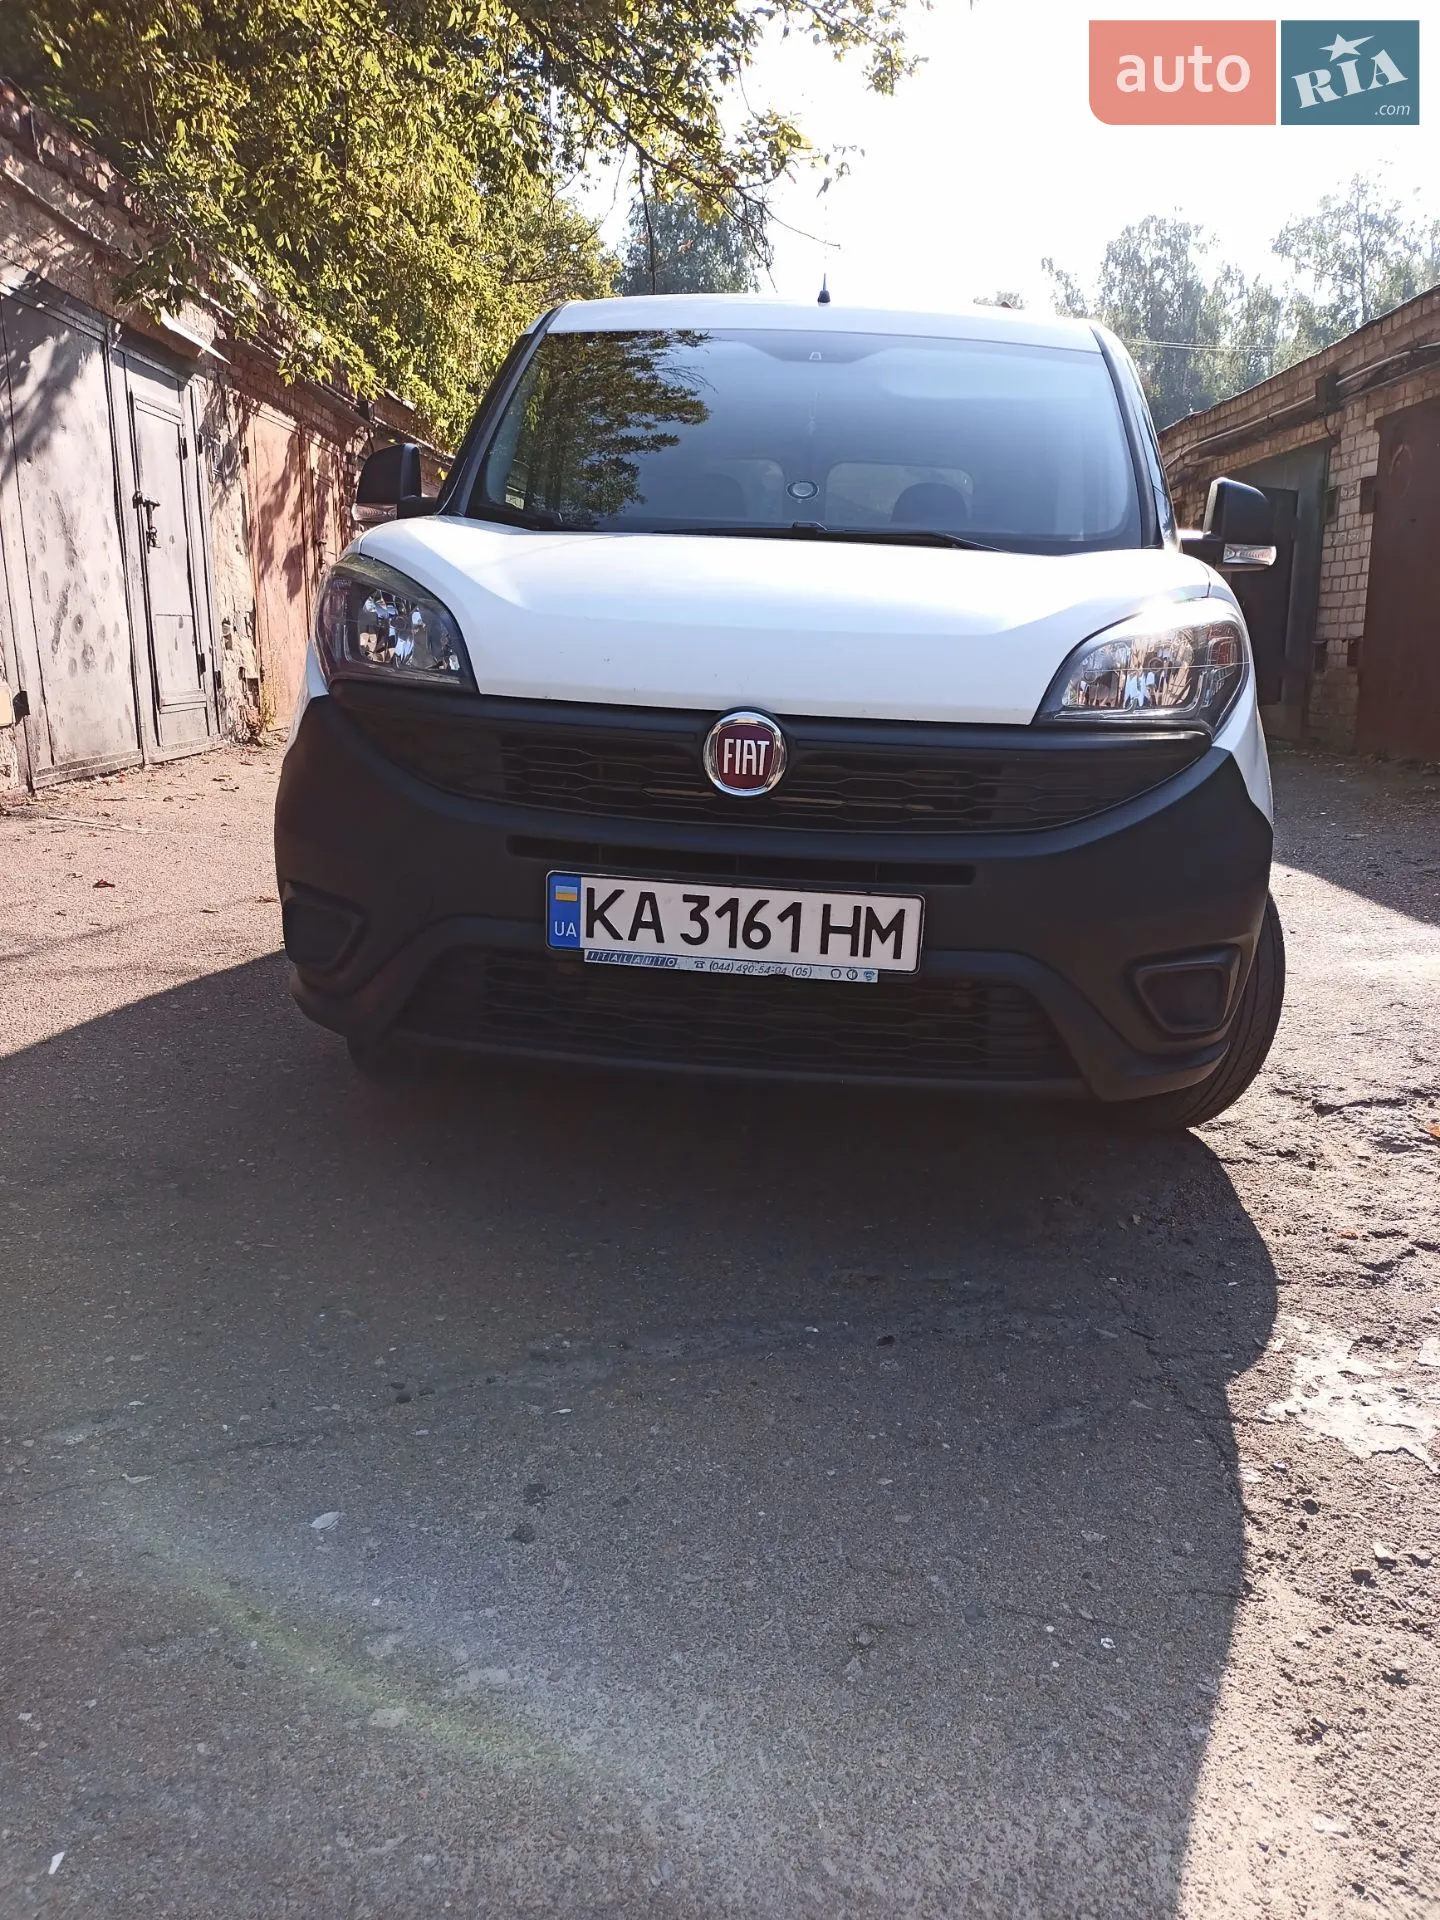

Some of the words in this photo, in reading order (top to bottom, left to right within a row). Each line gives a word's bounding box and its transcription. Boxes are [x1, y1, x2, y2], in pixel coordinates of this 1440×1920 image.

[723, 738, 770, 776] FIAT
[554, 920, 577, 938] UA
[585, 887, 665, 944] KA
[680, 894, 803, 953] 3161
[819, 903, 906, 960] HM
[588, 950, 678, 968] ITALAUTO
